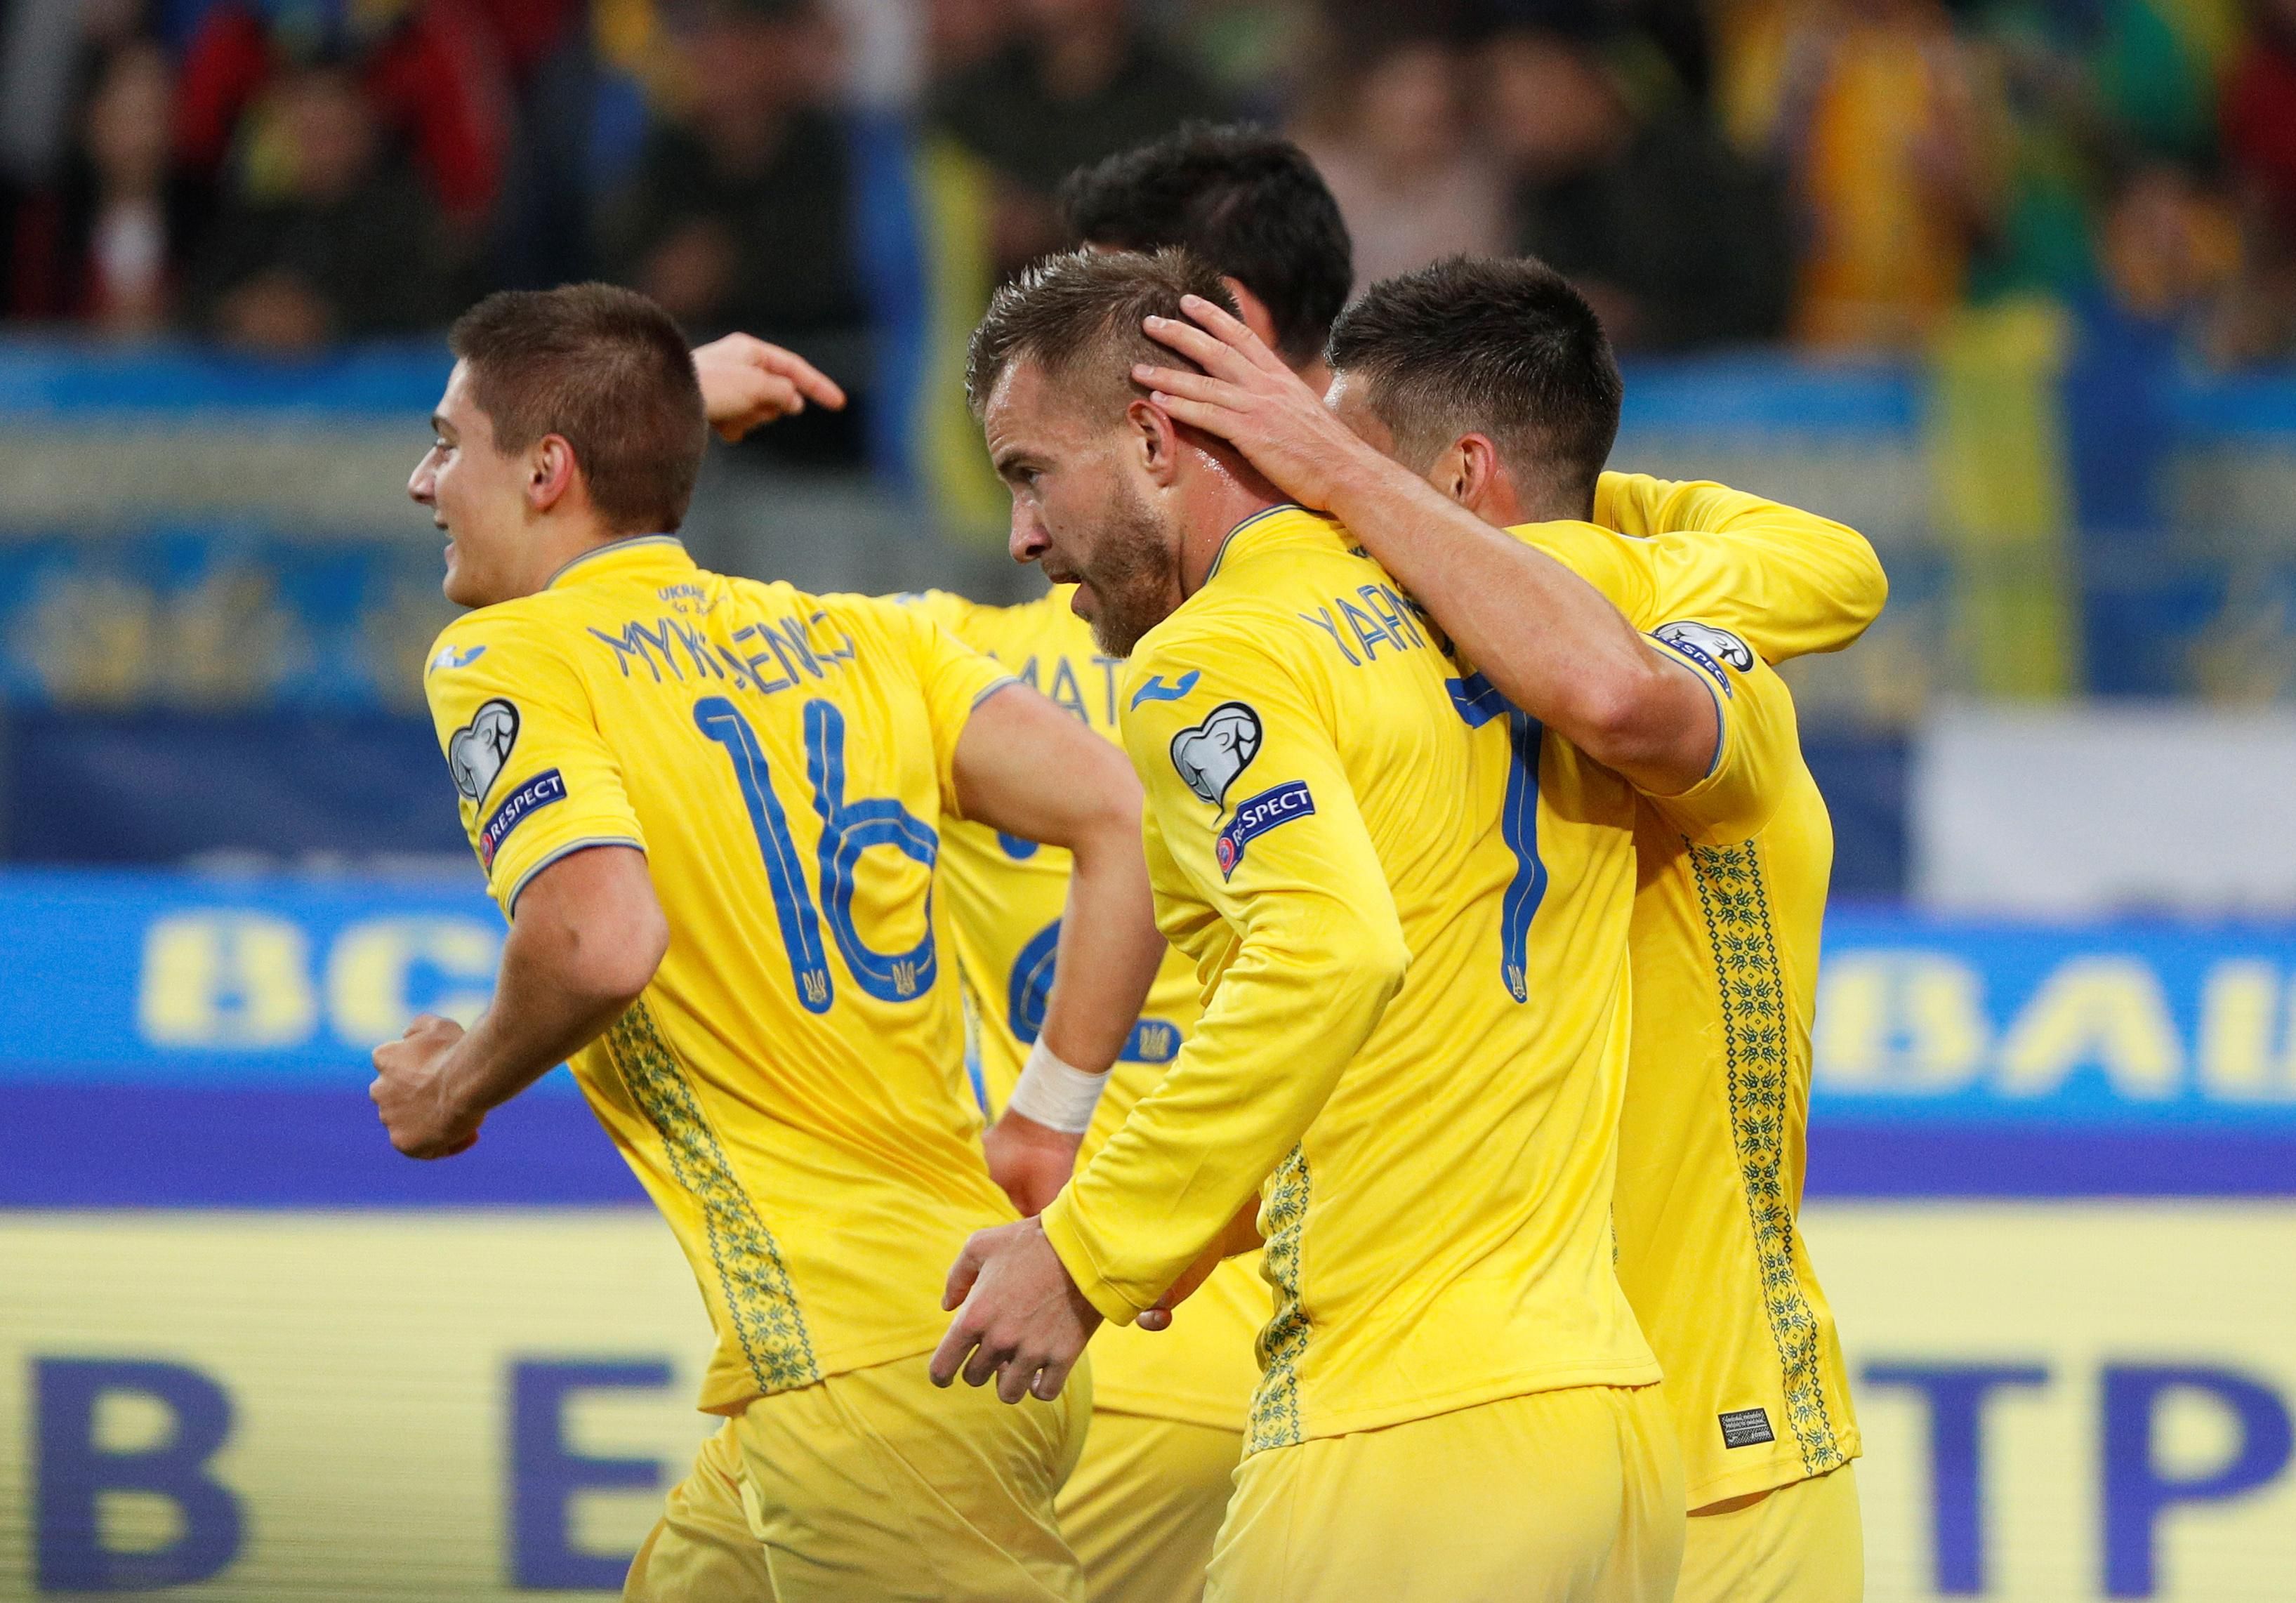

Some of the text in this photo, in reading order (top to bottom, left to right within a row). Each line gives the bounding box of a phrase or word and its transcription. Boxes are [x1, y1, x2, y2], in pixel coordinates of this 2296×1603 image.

[490, 775, 560, 842] RESPECT
[693, 695, 939, 1014] 16
[1444, 671, 1548, 1003] 7
